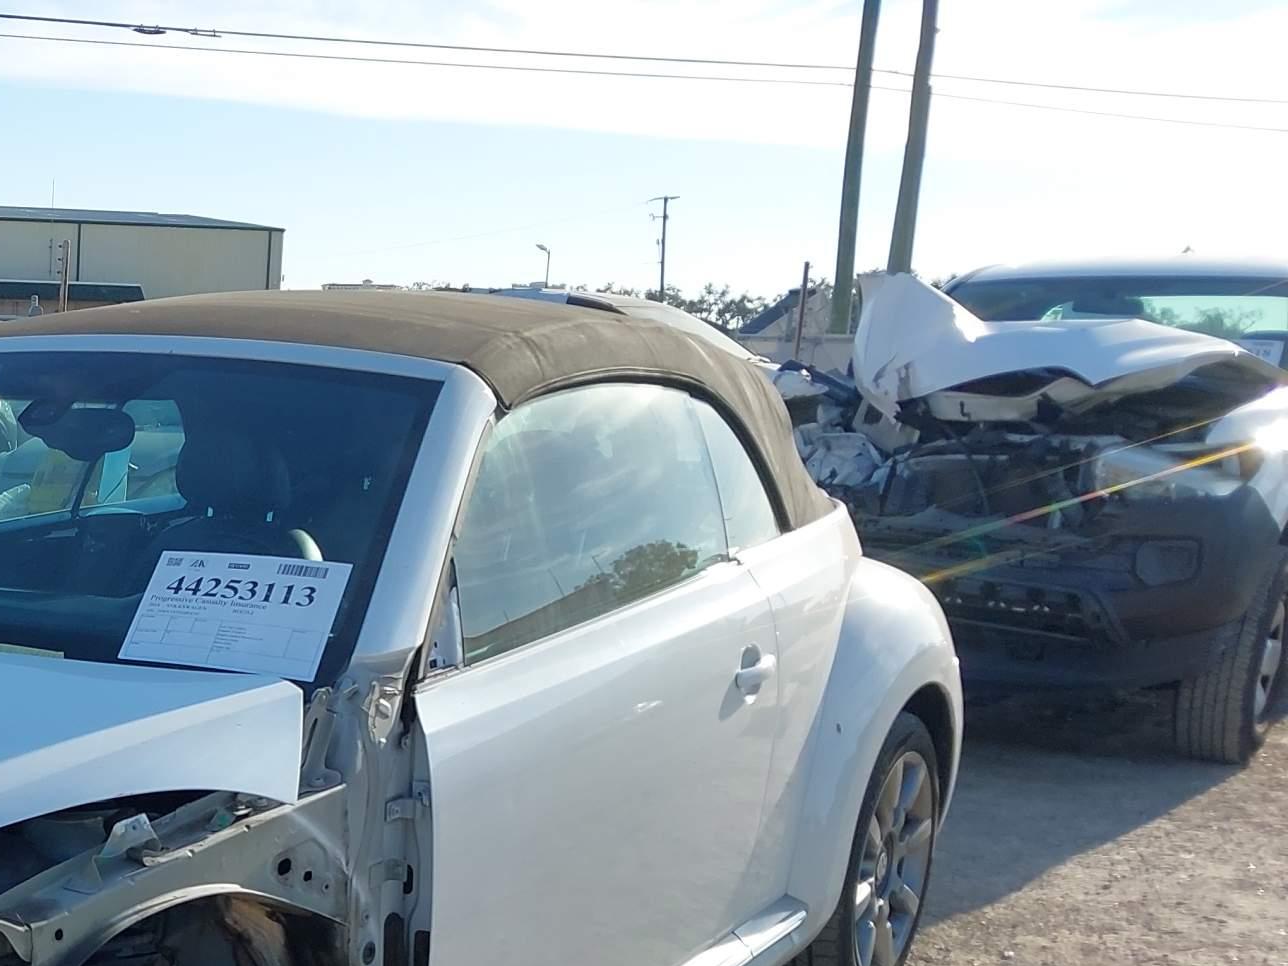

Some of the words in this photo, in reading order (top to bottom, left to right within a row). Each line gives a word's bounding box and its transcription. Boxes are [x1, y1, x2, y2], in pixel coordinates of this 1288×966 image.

[166, 575, 317, 607] 44253113
[194, 597, 227, 607] Casualty
[230, 600, 268, 611] Insurance
